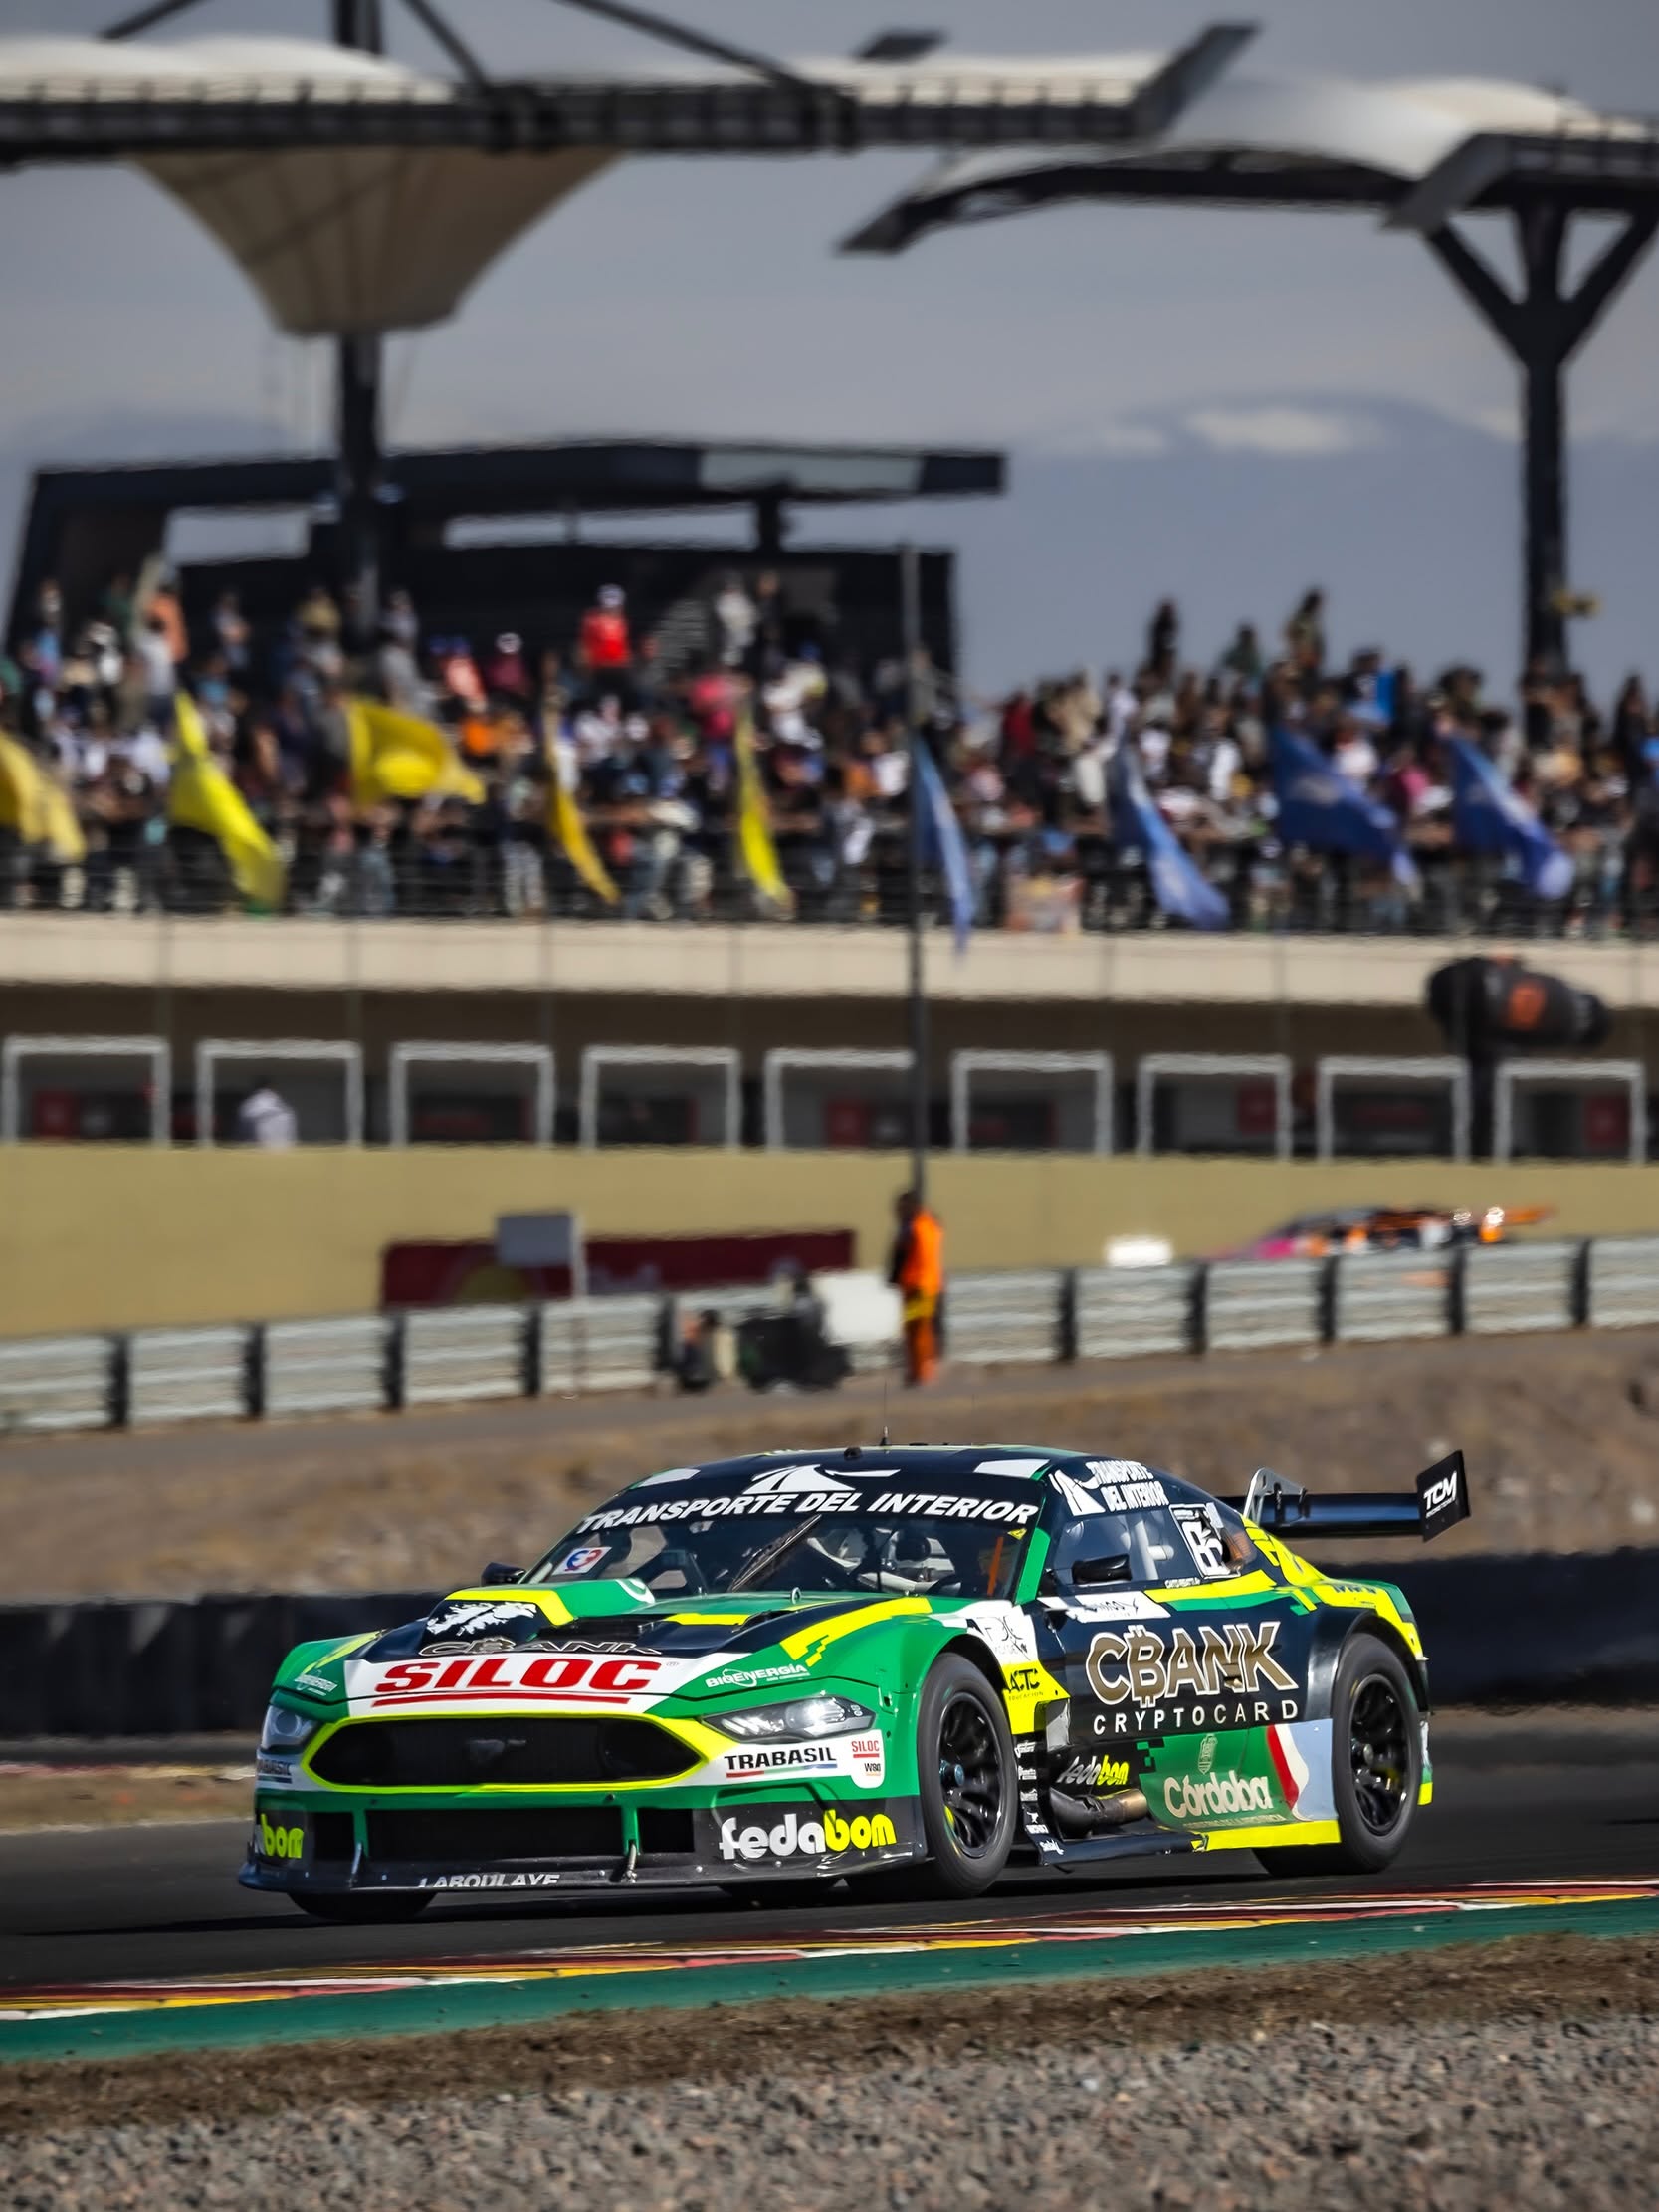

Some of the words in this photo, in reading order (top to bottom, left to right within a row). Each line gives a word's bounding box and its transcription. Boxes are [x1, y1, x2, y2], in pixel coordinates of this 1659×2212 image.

[1086, 1460, 1154, 1485] TRANSPORTE
[1423, 1470, 1458, 1510] TCM
[576, 1493, 799, 1534] TRANSPORTE
[794, 1492, 863, 1513] DEL
[867, 1493, 1039, 1524] INTERIOR
[1101, 1485, 1127, 1512] DEL
[1120, 1481, 1170, 1510] INTERIOR
[374, 1658, 663, 1693] SILOC
[1086, 1621, 1300, 1709] CBANK
[1093, 1699, 1299, 1735] CRYPTOCARD
[725, 1747, 838, 1770] TRABASIL
[851, 1740, 880, 1753] SILOC
[1056, 1755, 1129, 1786] fedabom
[720, 1809, 897, 1860] fedabom
